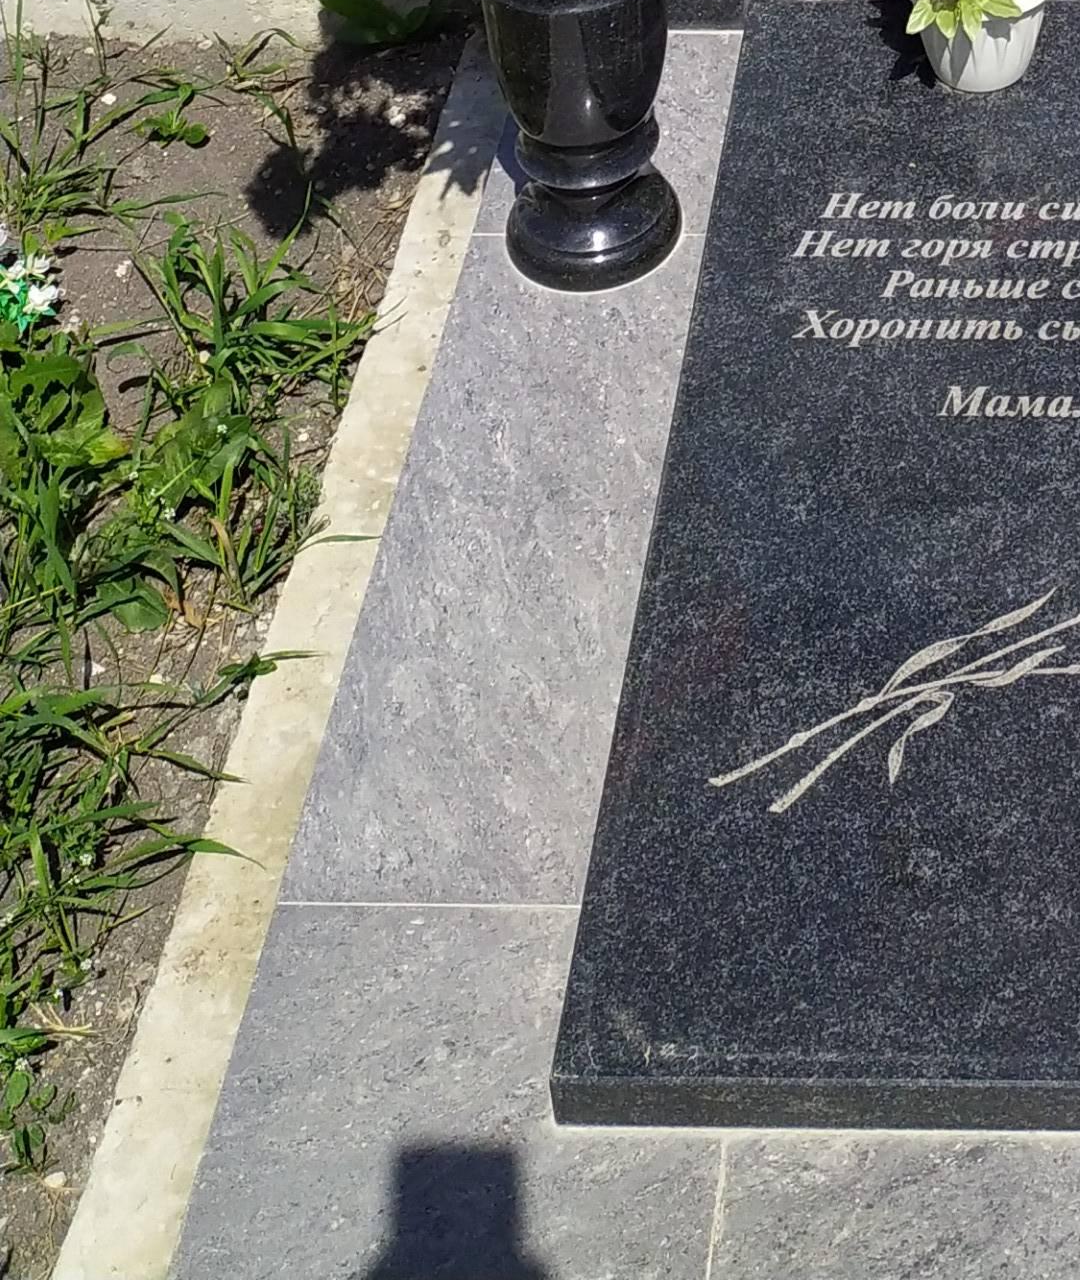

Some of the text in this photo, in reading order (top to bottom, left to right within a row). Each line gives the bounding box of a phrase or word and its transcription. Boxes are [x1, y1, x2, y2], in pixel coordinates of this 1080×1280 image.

[820, 192, 915, 220] Нет
[928, 194, 1026, 221] боли
[792, 230, 890, 259] Нет
[901, 239, 993, 266] горя
[880, 270, 1051, 301] Раньше
[792, 310, 1024, 348] Хоронить
